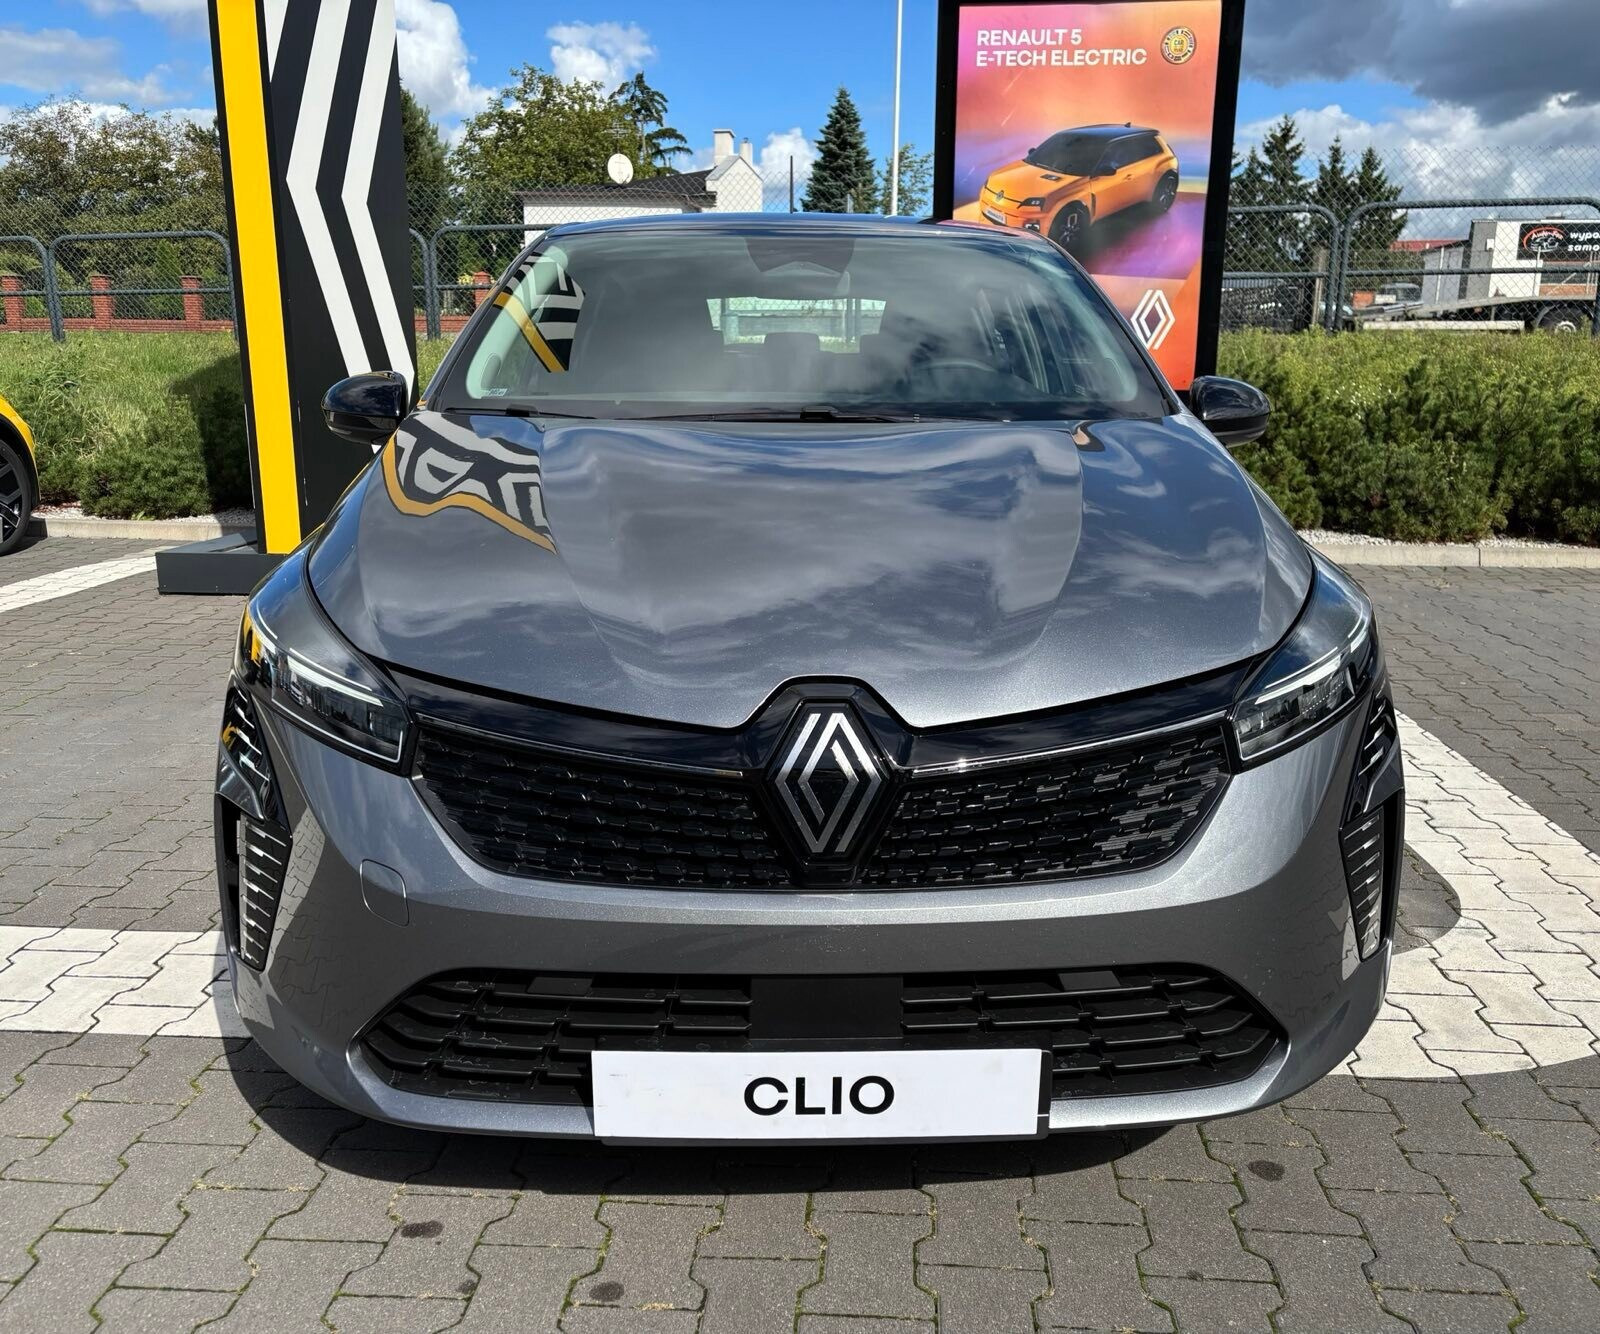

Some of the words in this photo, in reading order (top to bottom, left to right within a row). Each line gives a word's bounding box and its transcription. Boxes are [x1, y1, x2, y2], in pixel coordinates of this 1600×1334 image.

[976, 29, 1068, 46] RENAULT
[1070, 29, 1082, 45] 5
[976, 50, 1046, 66] E-TECH
[1050, 48, 1147, 66] ELECTRIC
[1569, 231, 1600, 242] wypo
[744, 1075, 895, 1116] CLIO
